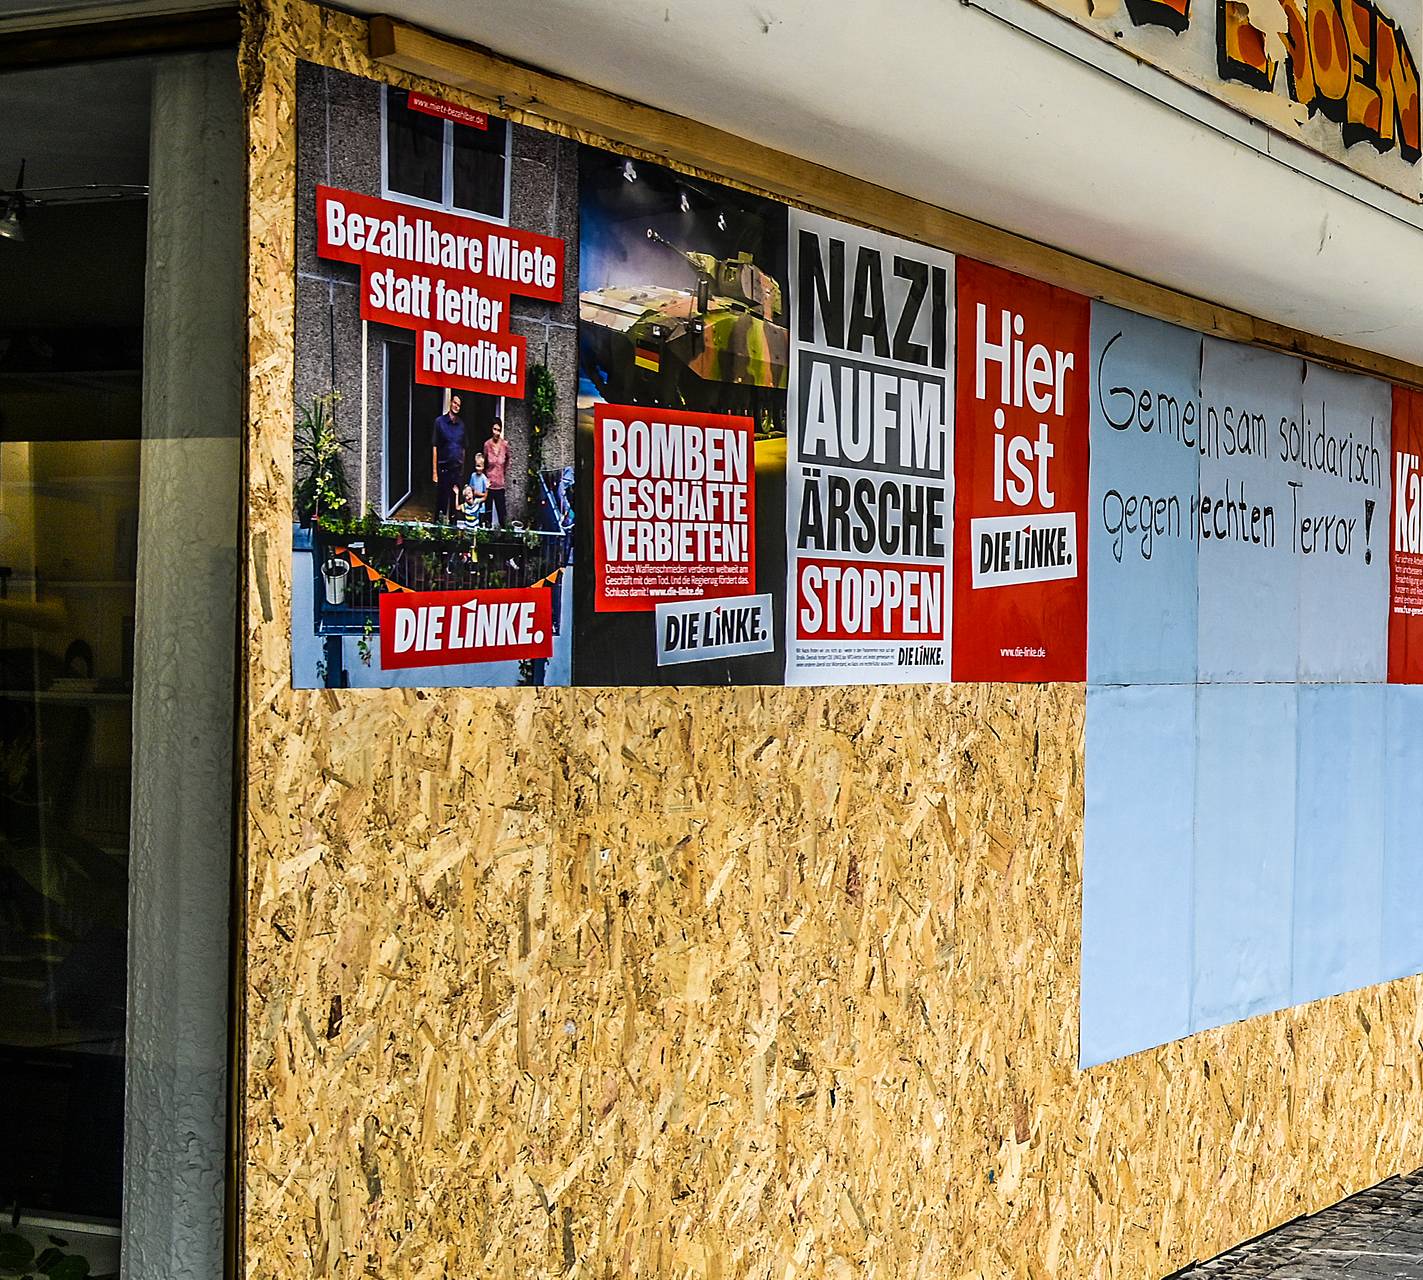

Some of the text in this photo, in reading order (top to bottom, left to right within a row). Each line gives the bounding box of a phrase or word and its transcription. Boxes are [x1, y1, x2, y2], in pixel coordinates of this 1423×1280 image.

[326, 199, 557, 288] Bezahlbare Miete
[369, 269, 503, 334] statt fetter
[798, 229, 947, 370] NAZI
[422, 330, 518, 384] Rendite!
[975, 302, 1075, 416] Hier
[1098, 331, 1382, 489] Gemeinsam solidarisch
[602, 418, 748, 482] BOMBEN
[993, 409, 1055, 509] ist
[602, 478, 748, 522] GESCHÄFTE
[797, 467, 945, 558] ÄRSCHE
[1103, 489, 1181, 563] gegen
[1190, 479, 1275, 548] rechten
[1288, 481, 1358, 555] Terror
[602, 520, 749, 563] VERBIETEN!
[605, 563, 635, 574] Deutsche
[979, 529, 1009, 574] DIE
[605, 575, 633, 585] Geschäft
[633, 575, 643, 585] mit
[643, 575, 657, 585] dem
[605, 587, 629, 597] Schluss
[800, 564, 942, 635] STOPPEN
[394, 605, 445, 654] DIE
[664, 612, 700, 652] DIE
[898, 647, 913, 666] DIE
